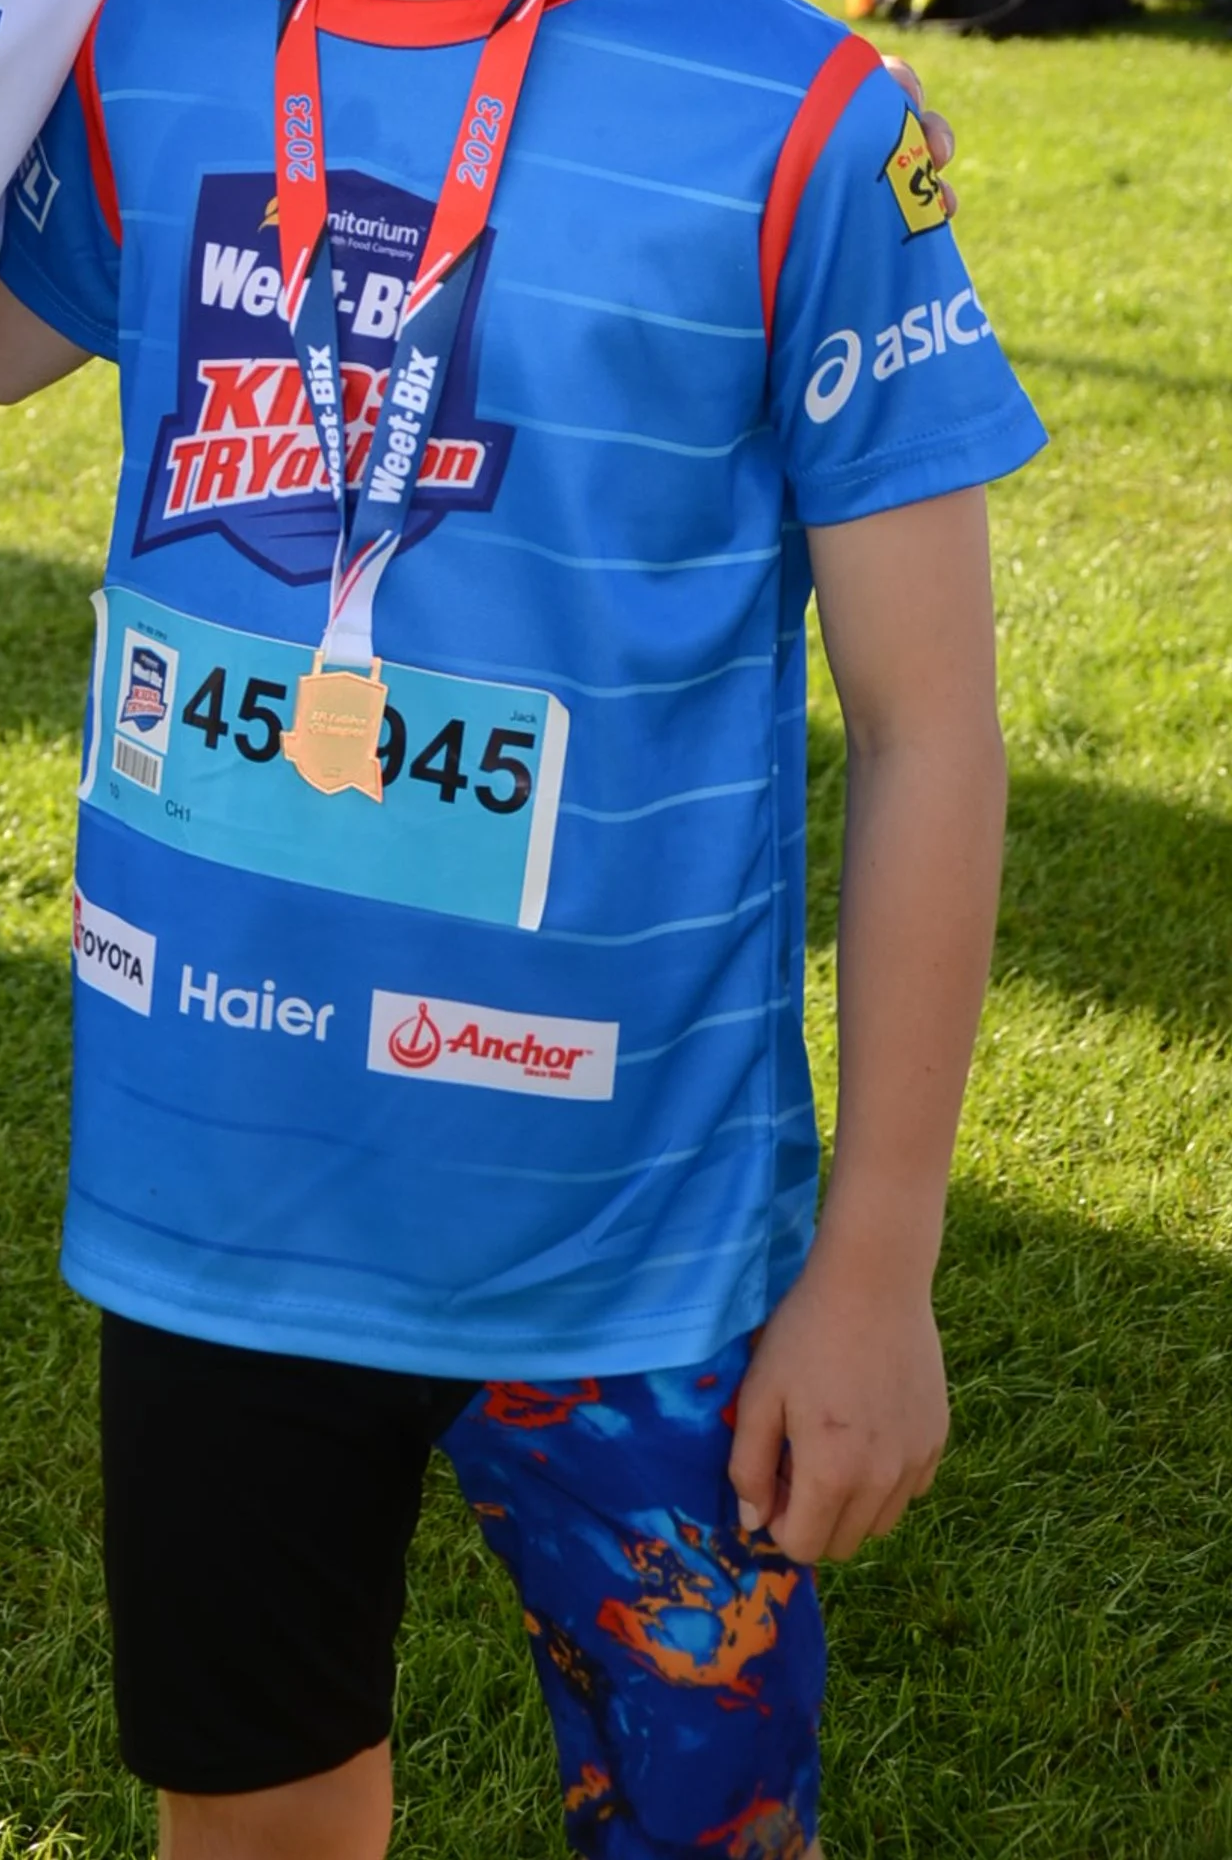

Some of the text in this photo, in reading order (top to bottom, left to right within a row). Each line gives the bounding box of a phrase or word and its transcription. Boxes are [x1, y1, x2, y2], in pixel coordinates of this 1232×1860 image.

[284, 94, 316, 182] 2023
[456, 95, 505, 190] 2023
[327, 209, 420, 247] nitarium
[307, 344, 341, 501] Weet-Bix
[368, 345, 439, 504] Weet-Bix
[509, 709, 537, 725] Jack
[165, 799, 191, 822] CH1
[179, 964, 335, 1042] Haier
[445, 1022, 585, 1071] Anchor
